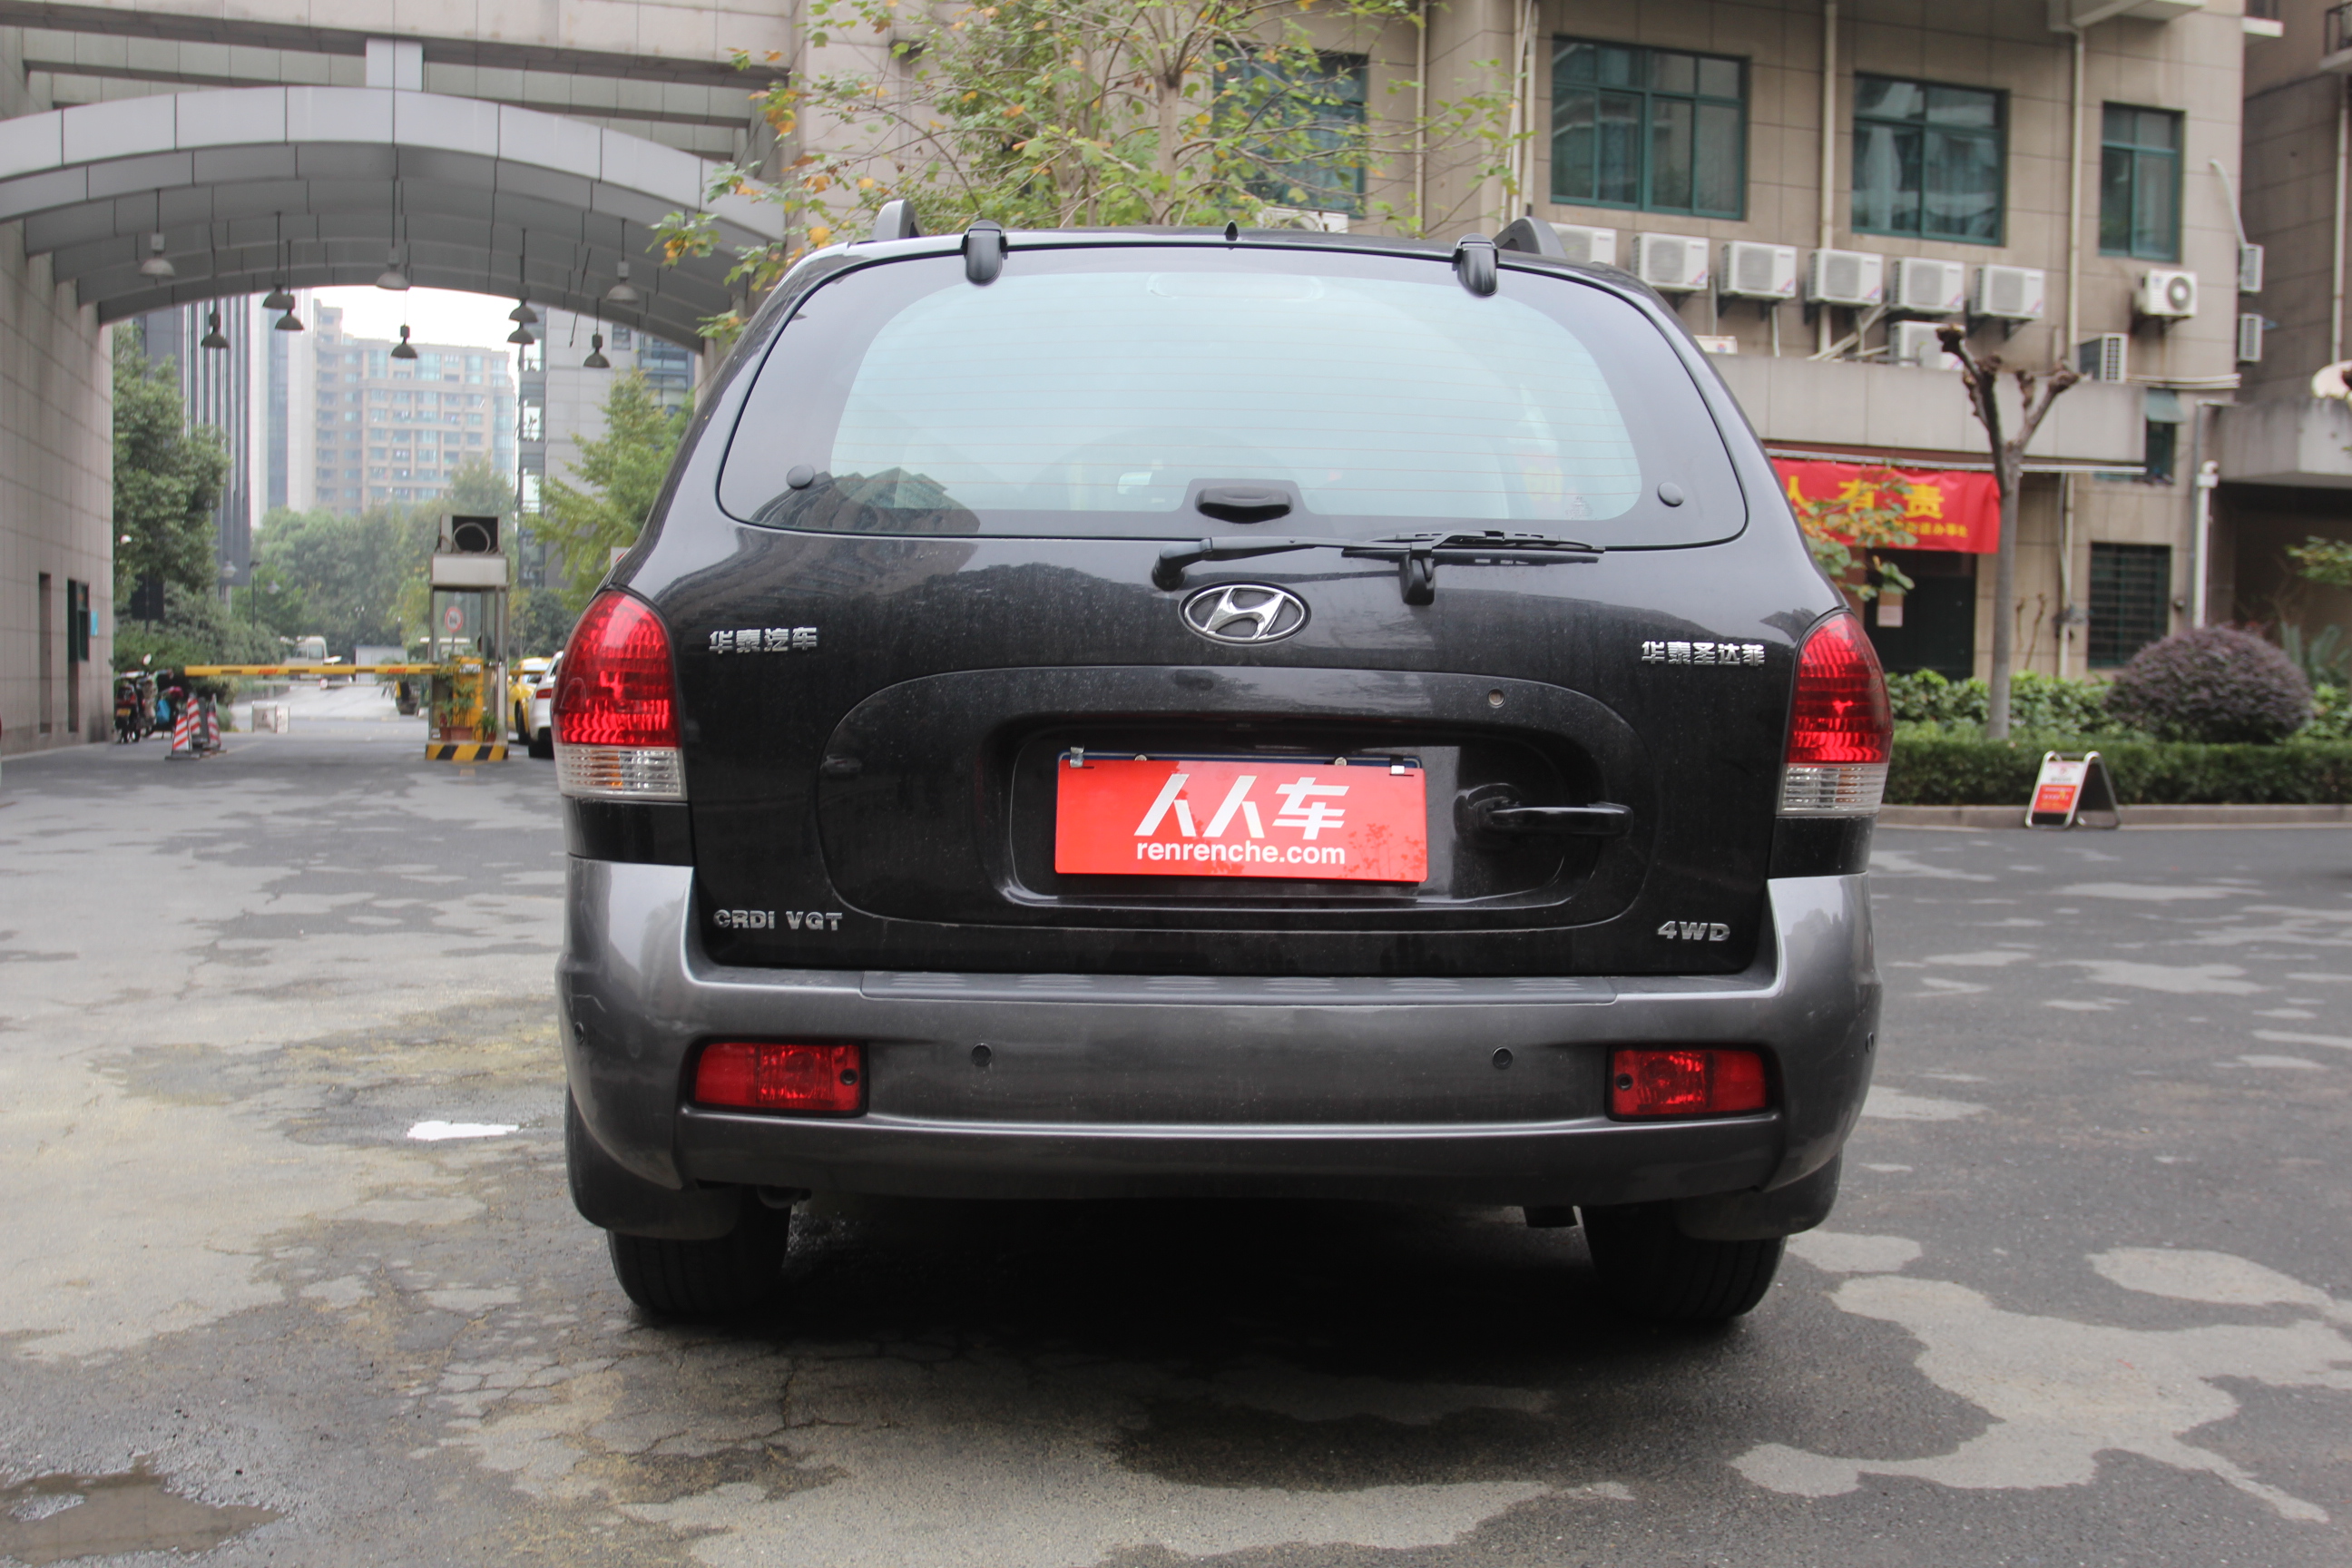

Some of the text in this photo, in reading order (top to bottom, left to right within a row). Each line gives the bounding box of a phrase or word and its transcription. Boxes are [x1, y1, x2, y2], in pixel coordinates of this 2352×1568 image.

[709, 627, 818, 654] 华泰汽车
[1642, 641, 1765, 667] 华泰圣达菲
[1133, 773, 1350, 840] 人人车
[1136, 840, 1346, 865] renrenche.com
[786, 910, 843, 932] VGT
[1657, 920, 1731, 942] 4WD
